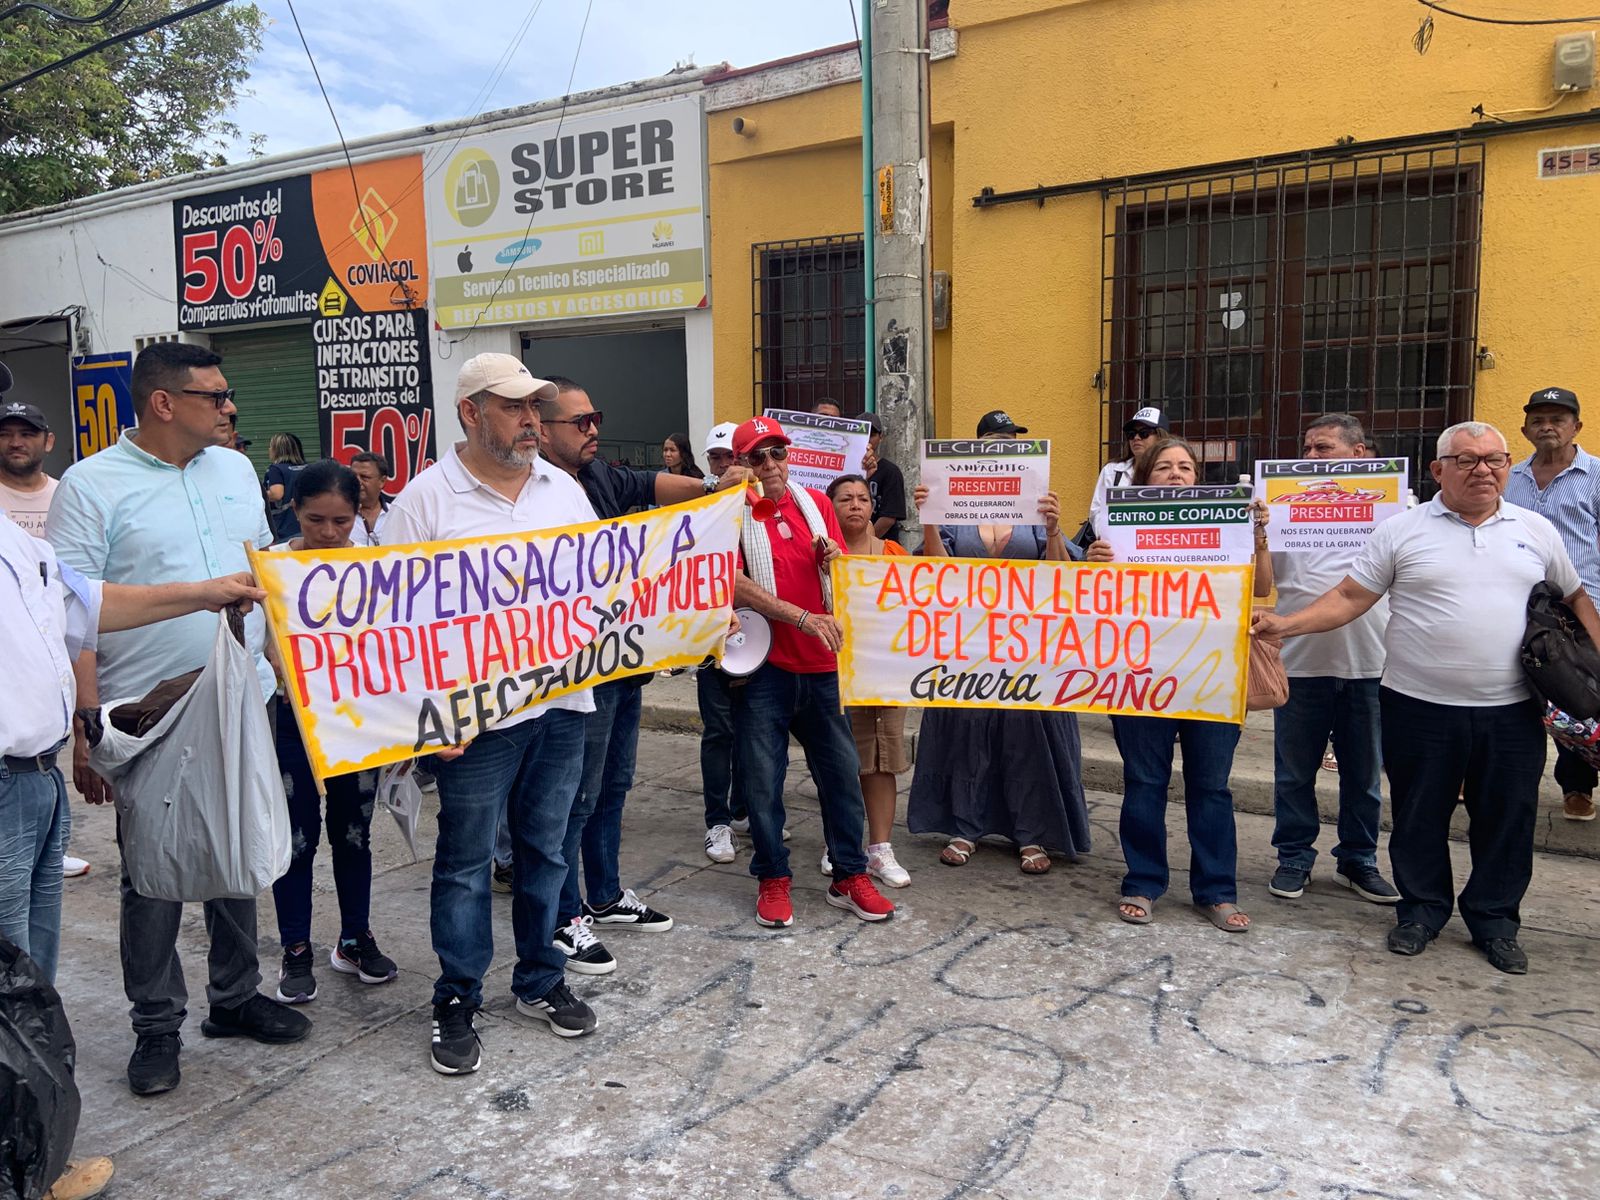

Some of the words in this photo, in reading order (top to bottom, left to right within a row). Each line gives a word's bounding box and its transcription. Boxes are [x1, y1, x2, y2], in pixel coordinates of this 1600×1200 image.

[511, 119, 674, 185] SUPER
[513, 166, 675, 214] STORE
[182, 196, 260, 229] Descuentos
[261, 188, 282, 216] del
[500, 244, 537, 258] SAMSUNG
[652, 241, 674, 249] HUAWEI
[183, 215, 283, 304] 50%
[347, 260, 419, 286] COVIACOL
[258, 273, 276, 294] en
[463, 277, 515, 298] Servicio
[518, 271, 570, 291] Tecnico
[572, 260, 670, 288] Especializado
[180, 299, 248, 327] Comparendos
[454, 301, 547, 324] REPUESTOS
[551, 298, 564, 315] Y
[567, 288, 685, 314] ACCESORIOS
[313, 315, 371, 344] CURSOS
[375, 313, 416, 339] PARA
[317, 340, 419, 367] INFRACTORES
[318, 368, 338, 390] DE
[339, 365, 420, 389] TRANSITO
[320, 388, 397, 409] Descuentos
[400, 386, 420, 405] del
[751, 419, 769, 434] LA
[949, 480, 1020, 493] PRESENTE!!
[1108, 511, 1156, 522] CENTRO
[1159, 510, 1175, 521] DE
[1179, 507, 1249, 521] COPIADO
[1290, 506, 1373, 519] PRESENTE!!
[1136, 532, 1220, 546] PRESENTE!!
[298, 521, 646, 629] COMPENSACIÓN
[669, 514, 695, 568] A
[1127, 555, 1145, 563] NOS
[1146, 555, 1172, 563] ESTAN
[1173, 554, 1230, 563] QUEBRANDO!
[876, 560, 1035, 612] ACCIÓN
[1053, 568, 1221, 620] LEGITIMA
[286, 596, 598, 708] PROPIETARIOS
[907, 608, 970, 662] DEL
[988, 611, 1152, 672] ESTADO
[413, 622, 645, 752] AFECTADOS
[909, 664, 1043, 703] Genera
[1052, 667, 1179, 712] DAÑO
